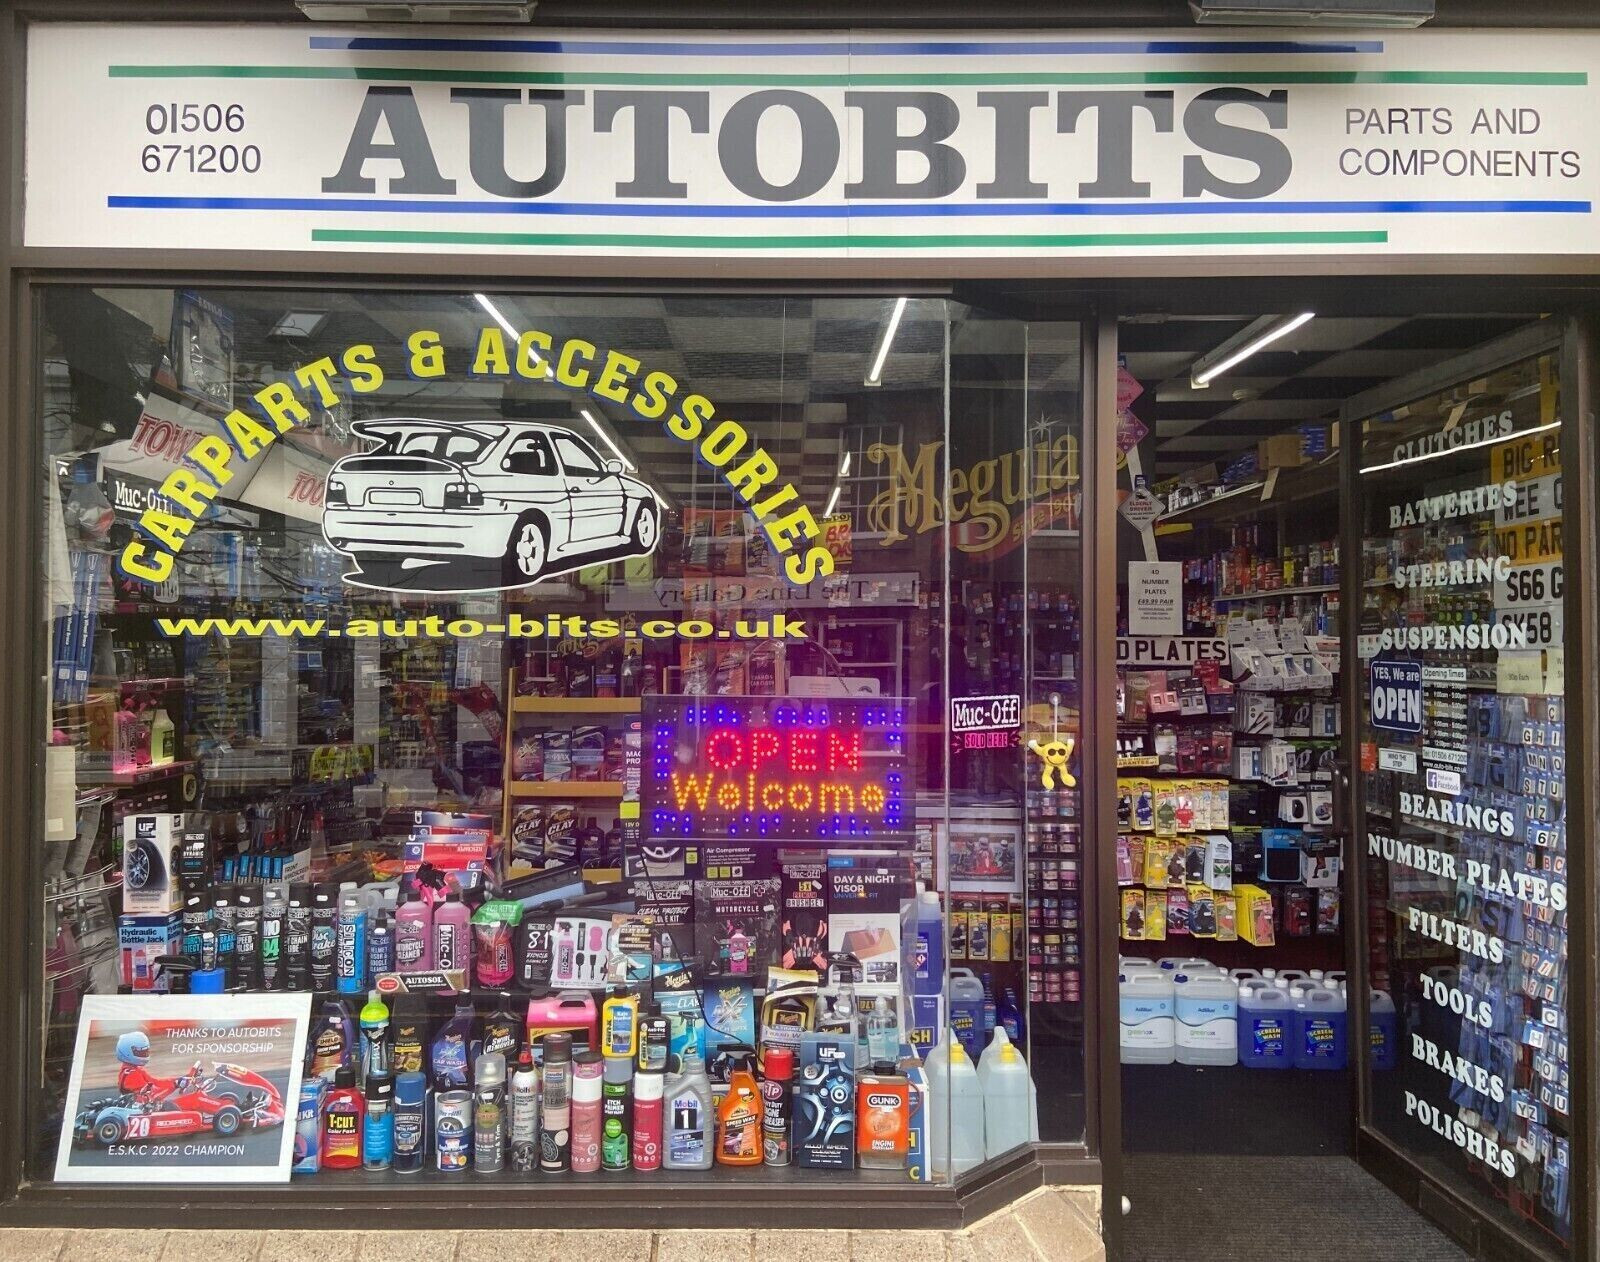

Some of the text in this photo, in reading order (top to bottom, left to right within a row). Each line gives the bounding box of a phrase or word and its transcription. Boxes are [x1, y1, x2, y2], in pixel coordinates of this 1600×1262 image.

[145, 103, 246, 135] 01506
[1345, 107, 1541, 135] PARTS AND
[321, 84, 1293, 203] AUTOBITS
[140, 144, 262, 174] 671200
[1338, 148, 1581, 178] COMPONENTS
[1392, 410, 1513, 464] CLUTCHES
[407, 330, 447, 379] &
[472, 327, 835, 586] ACCESSORIES
[1503, 444, 1533, 479] BIG
[1388, 480, 1517, 529] BATTERIES
[1394, 555, 1512, 589] STEERING
[1507, 568, 1545, 602] S66
[157, 613, 809, 639] www.auto-bits.co.uk
[1380, 622, 1528, 650] SUSPENSION
[1502, 612, 1552, 645] SK58
[1135, 639, 1227, 661] PLATES
[1374, 666, 1420, 682] YES, We are
[954, 699, 1018, 727] Muc-Off
[1373, 686, 1420, 724] OPEN
[706, 731, 863, 772] OPEN
[964, 732, 1009, 749] SOLD HERE
[671, 772, 886, 814] Welcome
[1399, 791, 1515, 837] BEARINGS
[514, 818, 542, 835] CLAY
[548, 819, 575, 836] CLAY
[833, 875, 896, 884] DAY & NIGHT
[1368, 832, 1568, 912] NUMBER PLATES
[712, 886, 749, 897] Muc-Off
[833, 884, 865, 893] VISOR
[715, 905, 760, 913] MOTORCYCLE
[786, 898, 824, 907] BRUSH SET
[669, 915, 680, 923] KIT
[120, 928, 158, 938] Hydraulic
[120, 936, 145, 944] Bottle
[146, 935, 165, 944] Jack
[1408, 906, 1504, 964] FILTERS
[343, 924, 356, 977] SILICON
[405, 976, 444, 985] AUTOSOL
[1420, 972, 1493, 1029] TOOLS
[166, 1027, 282, 1039] THANKS TO AUTOBITS
[172, 1042, 274, 1054] FOR SPONSORSHIP
[486, 1039, 515, 1053] REMOVER
[1411, 1033, 1505, 1103] BRAKES
[764, 1083, 780, 1097] STP
[870, 1096, 898, 1105] GUNK
[129, 1117, 149, 1138] 20
[329, 1114, 355, 1129] T-CUT
[680, 1109, 690, 1129] 1
[725, 1119, 742, 1127] SPEED
[742, 1115, 756, 1123] WAX
[871, 1139, 895, 1147] ENGINE
[1404, 1090, 1516, 1179] POLISHES
[108, 1144, 244, 1156] E.S.K.C 2022 CHAMPION
